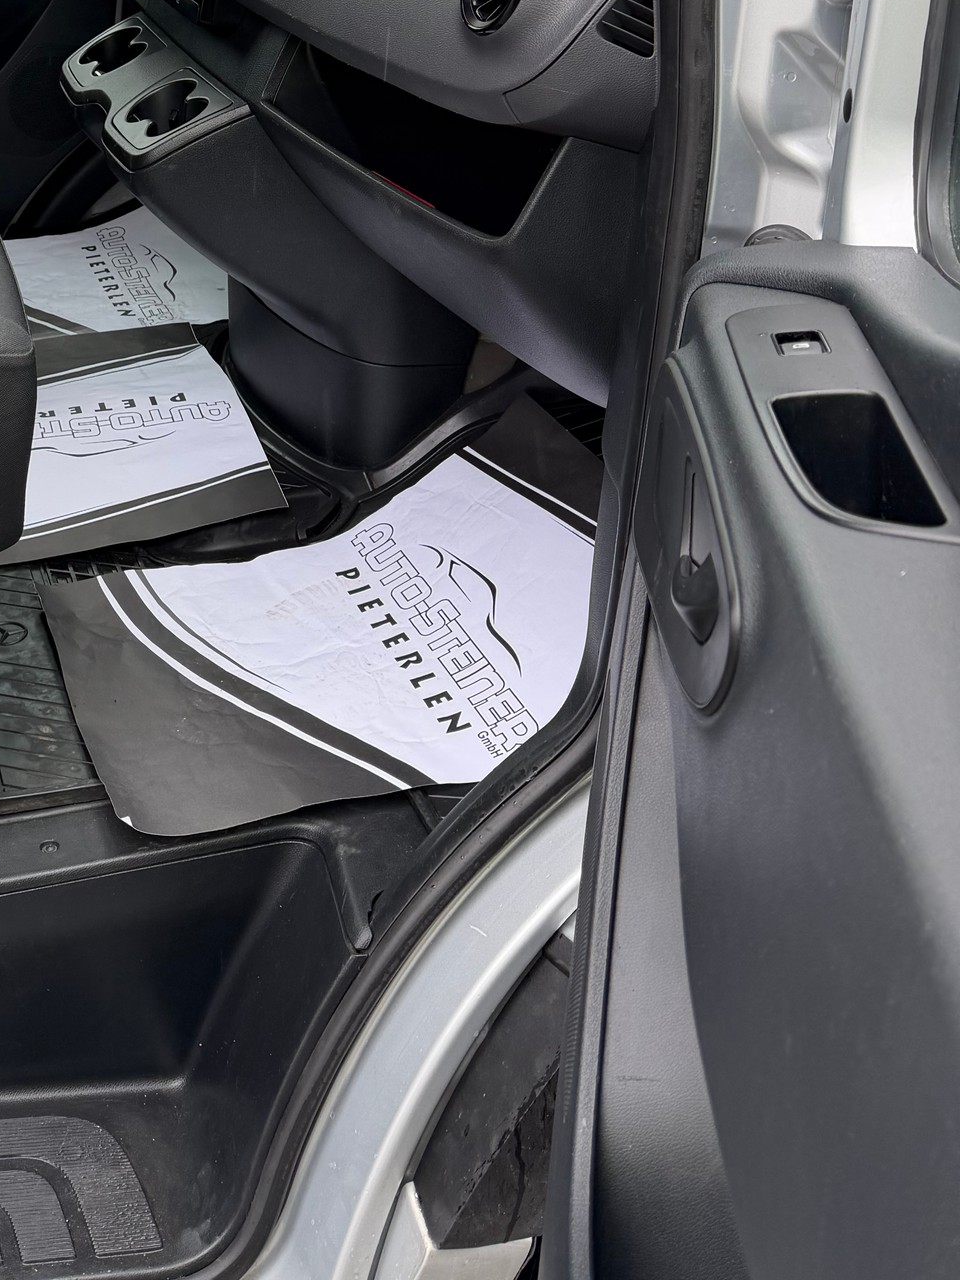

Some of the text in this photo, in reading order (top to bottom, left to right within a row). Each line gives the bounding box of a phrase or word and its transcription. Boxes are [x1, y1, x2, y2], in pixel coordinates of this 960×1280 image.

[81, 245, 136, 317] PIETERLEN
[37, 392, 187, 418] PIETER
[335, 566, 472, 734] PIETERLEN
[477, 731, 505, 758] GmbH
